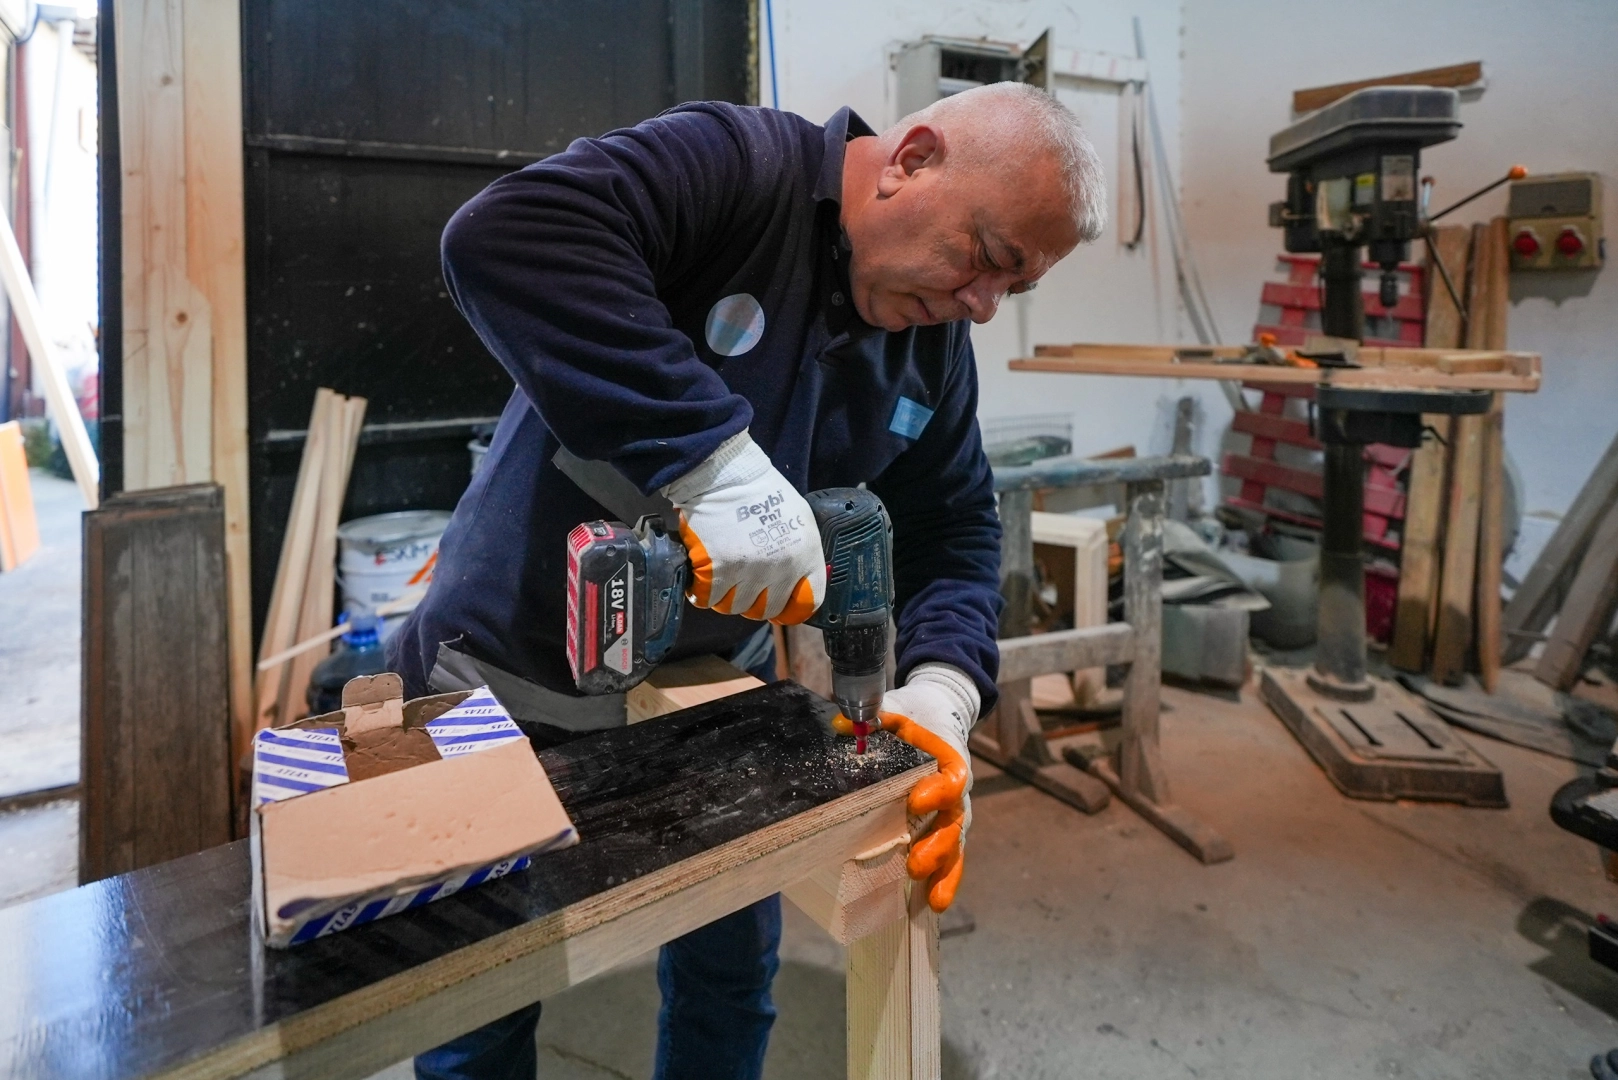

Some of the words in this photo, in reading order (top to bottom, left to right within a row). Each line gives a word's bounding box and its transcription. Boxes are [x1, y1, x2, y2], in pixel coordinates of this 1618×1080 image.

[736, 489, 785, 523] Beybi
[759, 508, 782, 526] Pn7
[611, 579, 625, 610] 18V
